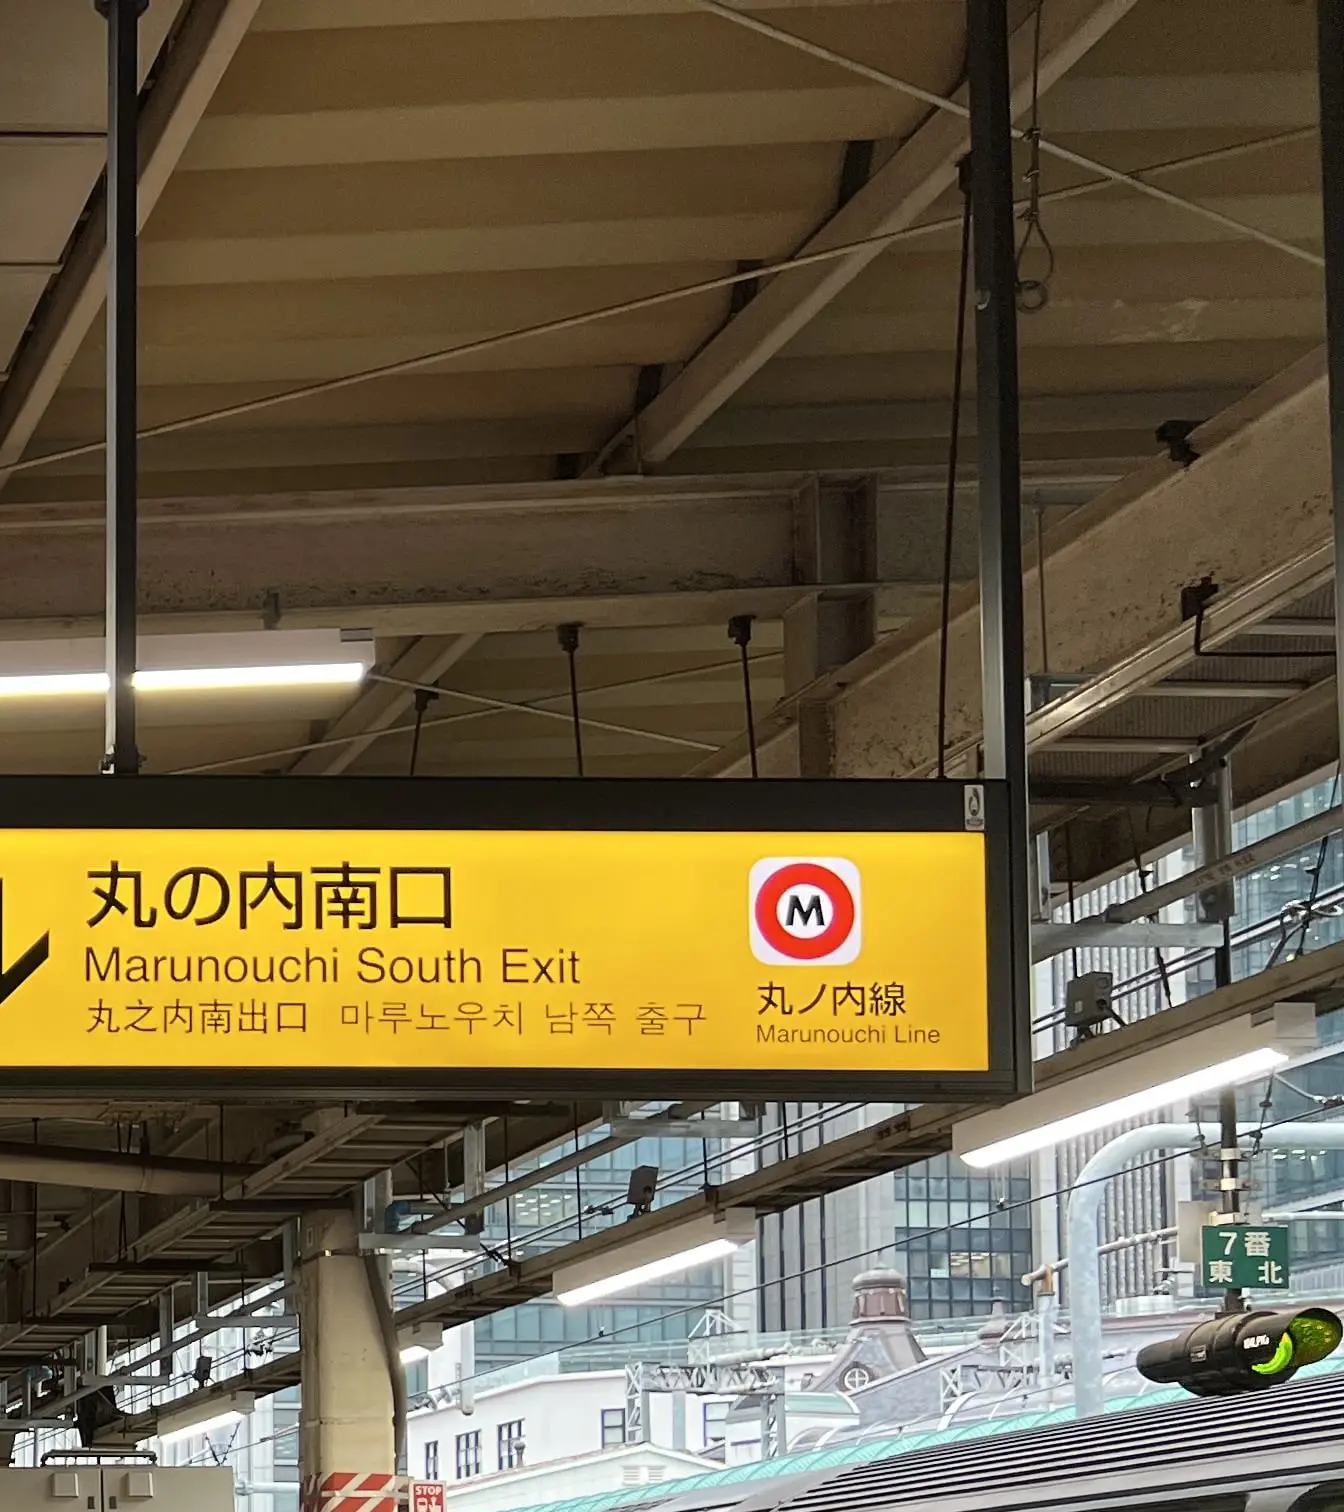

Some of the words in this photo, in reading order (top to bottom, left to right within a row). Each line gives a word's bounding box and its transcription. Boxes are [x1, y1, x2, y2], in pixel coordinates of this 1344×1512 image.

[86, 860, 453, 931] 丸の内南口
[785, 894, 826, 926] M
[85, 946, 339, 984] Marunouchi
[356, 948, 482, 985] South
[501, 948, 581, 985] Exit
[86, 998, 308, 1035] 丸之内南出口
[757, 981, 906, 1017] 丸ノ内線
[341, 1000, 525, 1036] 마루노우치
[544, 1000, 616, 1036] 남쪽
[635, 1000, 708, 1037] 출구
[756, 1024, 886, 1044] Marunouchi
[895, 1025, 940, 1044] Line
[1219, 1231, 1271, 1257] 7番
[415, 1486, 442, 1495] STOP
